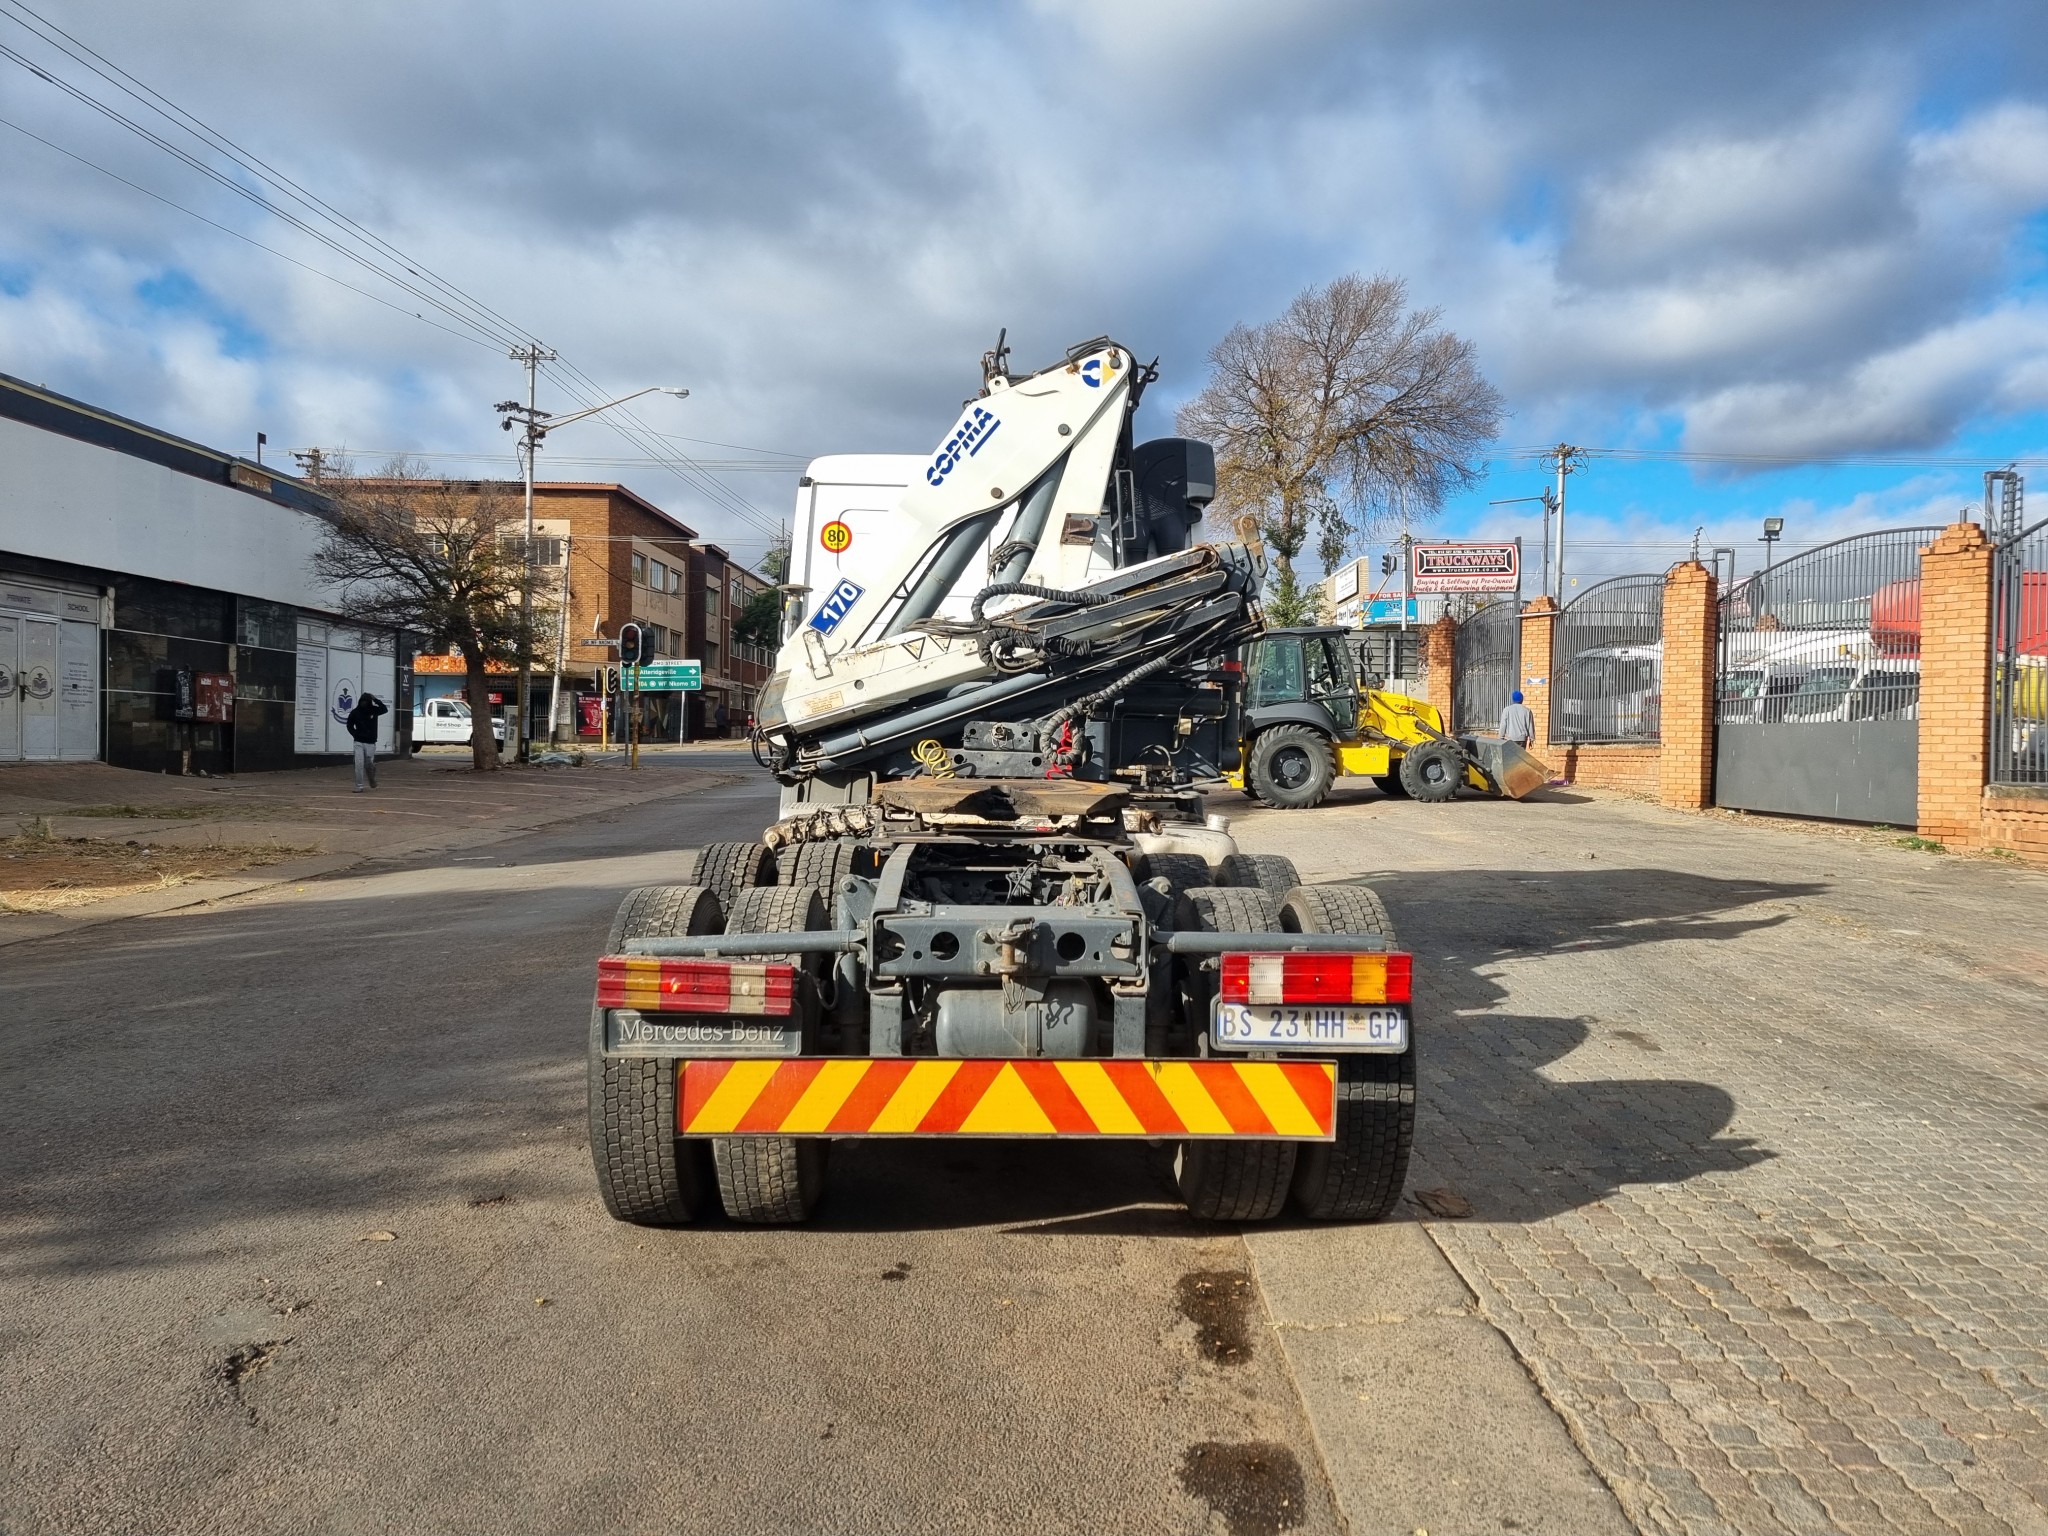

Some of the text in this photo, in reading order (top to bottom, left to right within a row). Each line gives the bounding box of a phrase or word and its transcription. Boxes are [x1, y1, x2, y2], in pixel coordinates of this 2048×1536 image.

[927, 407, 994, 486] COPMA
[828, 529, 846, 543] 80
[1427, 555, 1505, 566] TRUCKWAYS
[1416, 578, 1438, 586] Buying
[1447, 577, 1470, 585] Selling
[6, 594, 32, 604] PRIVATE
[67, 603, 90, 612] SCHOOL
[1223, 1008, 1398, 1039] BS 23 HH GP
[619, 1019, 784, 1041] Mercedes-Benz
